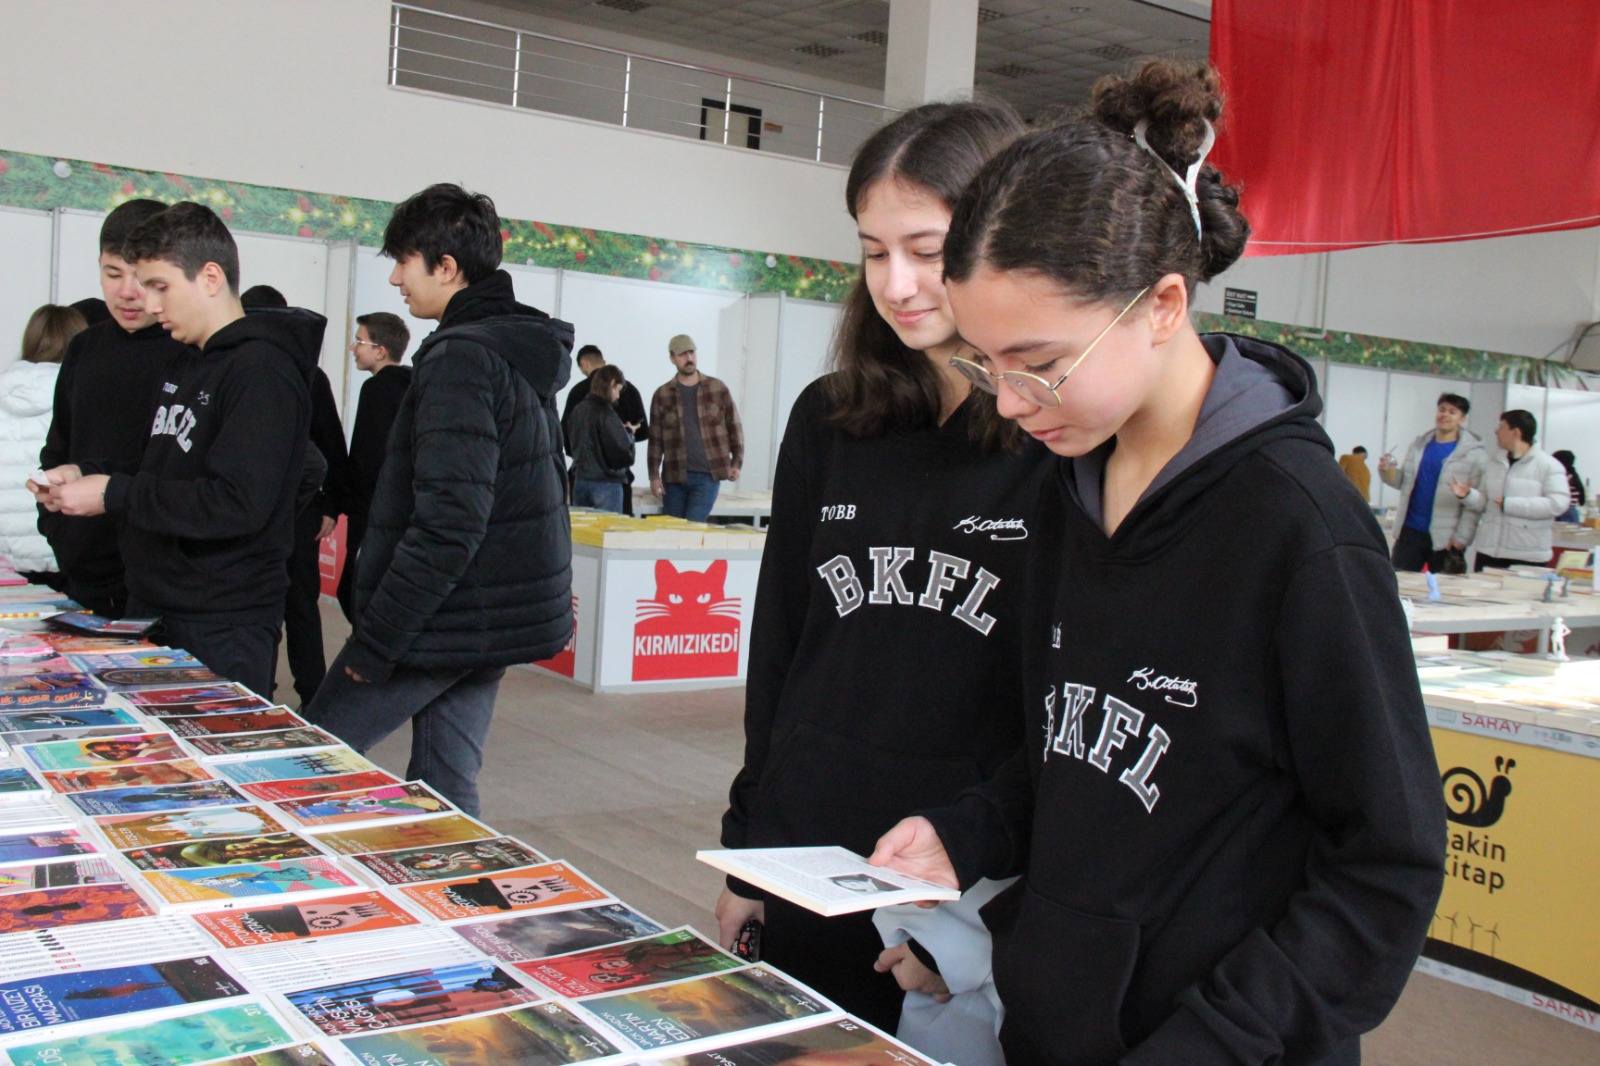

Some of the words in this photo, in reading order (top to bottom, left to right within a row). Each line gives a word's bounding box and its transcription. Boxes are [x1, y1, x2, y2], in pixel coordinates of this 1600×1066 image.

[151, 404, 197, 453] BKL
[821, 504, 856, 521] TOBB
[816, 547, 1001, 636] BKFL
[634, 628, 739, 657] KIRMIZIKEDİ
[1461, 711, 1522, 735] SARAY
[1448, 830, 1505, 863] akin
[1446, 853, 1505, 894] itap
[14, 1012, 43, 1028] BİR
[20, 983, 66, 1024] MACERASI
[1531, 991, 1598, 1025] SARAY
[648, 1017, 692, 1040] EDEN
